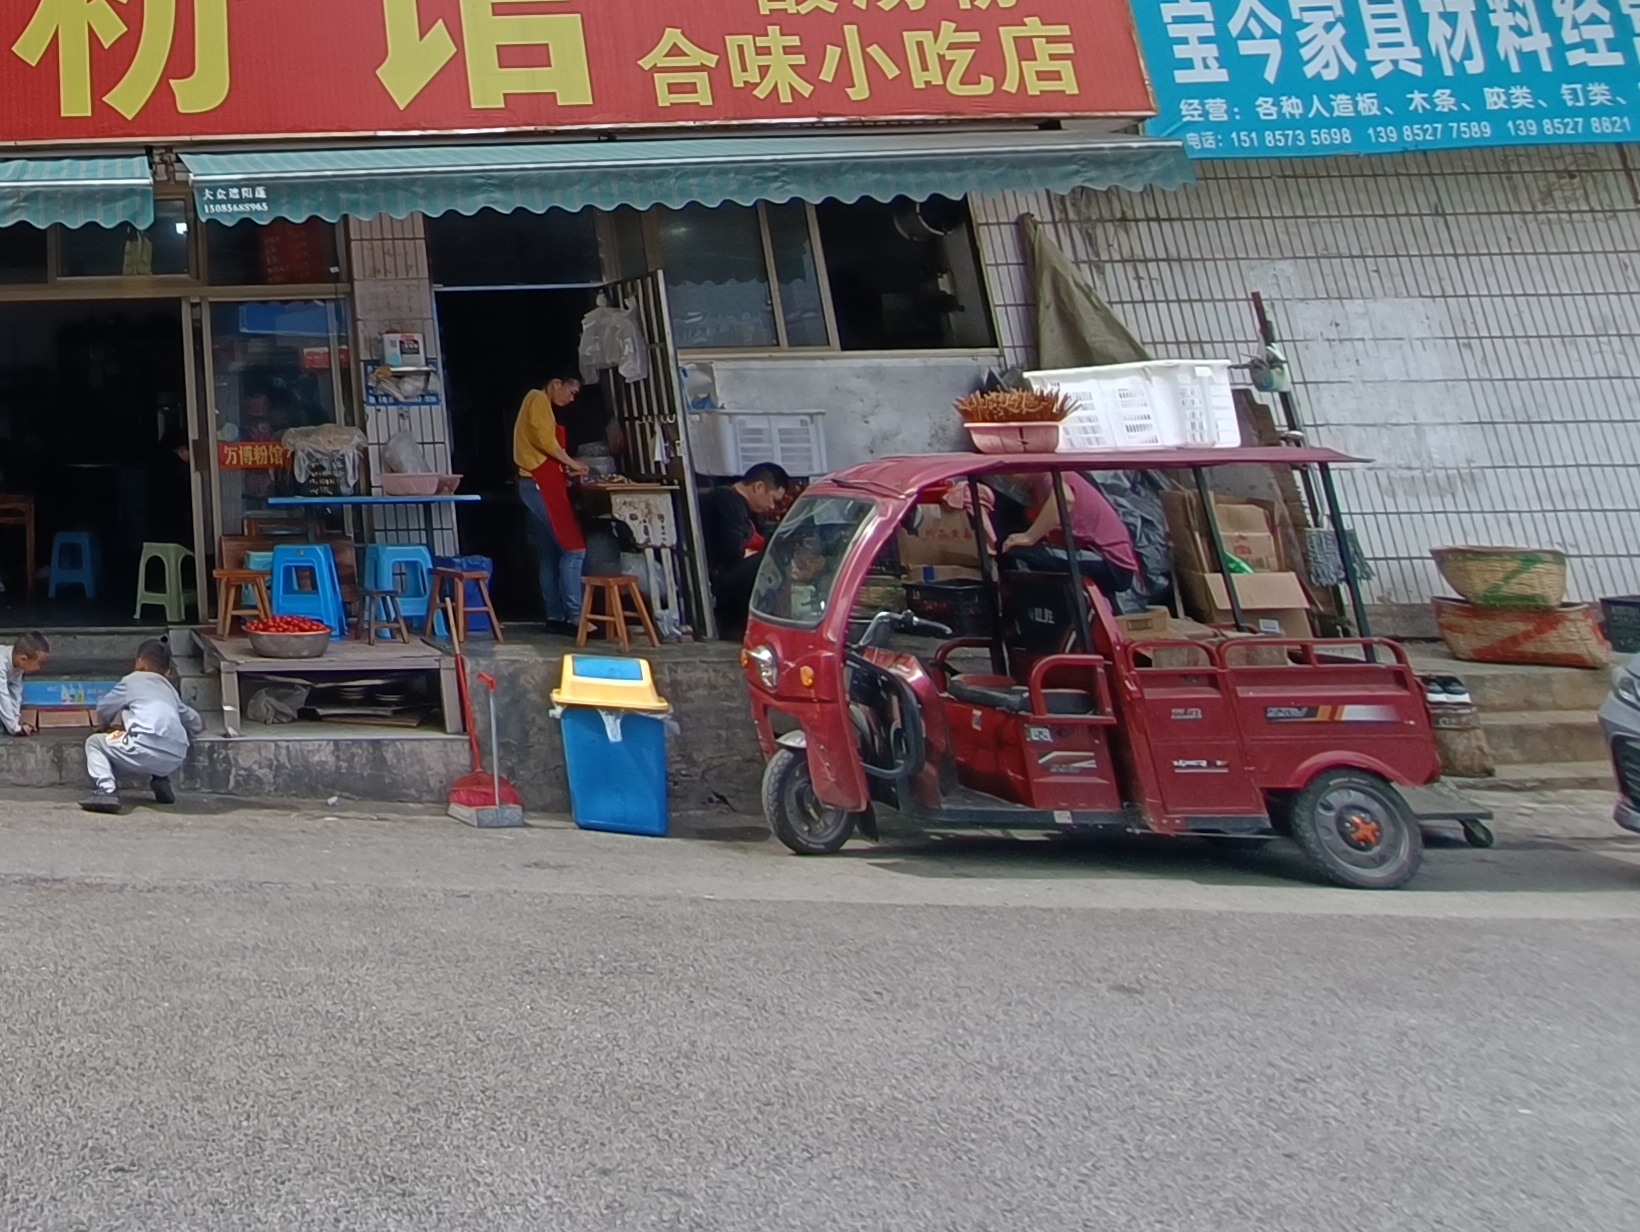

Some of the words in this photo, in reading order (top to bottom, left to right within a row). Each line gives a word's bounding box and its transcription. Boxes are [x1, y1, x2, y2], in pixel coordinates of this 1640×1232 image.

[637, 16, 1080, 107] 合味小吃店
[1230, 131, 1259, 149] 151
[1264, 128, 1306, 148] 8573
[1310, 126, 1353, 147] 5698
[1367, 124, 1399, 144] 139
[1402, 122, 1443, 142] 8527
[1448, 120, 1492, 139] 7589
[1507, 119, 1538, 136] 139
[1542, 117, 1584, 135] 8527
[1591, 115, 1631, 134] 8821
